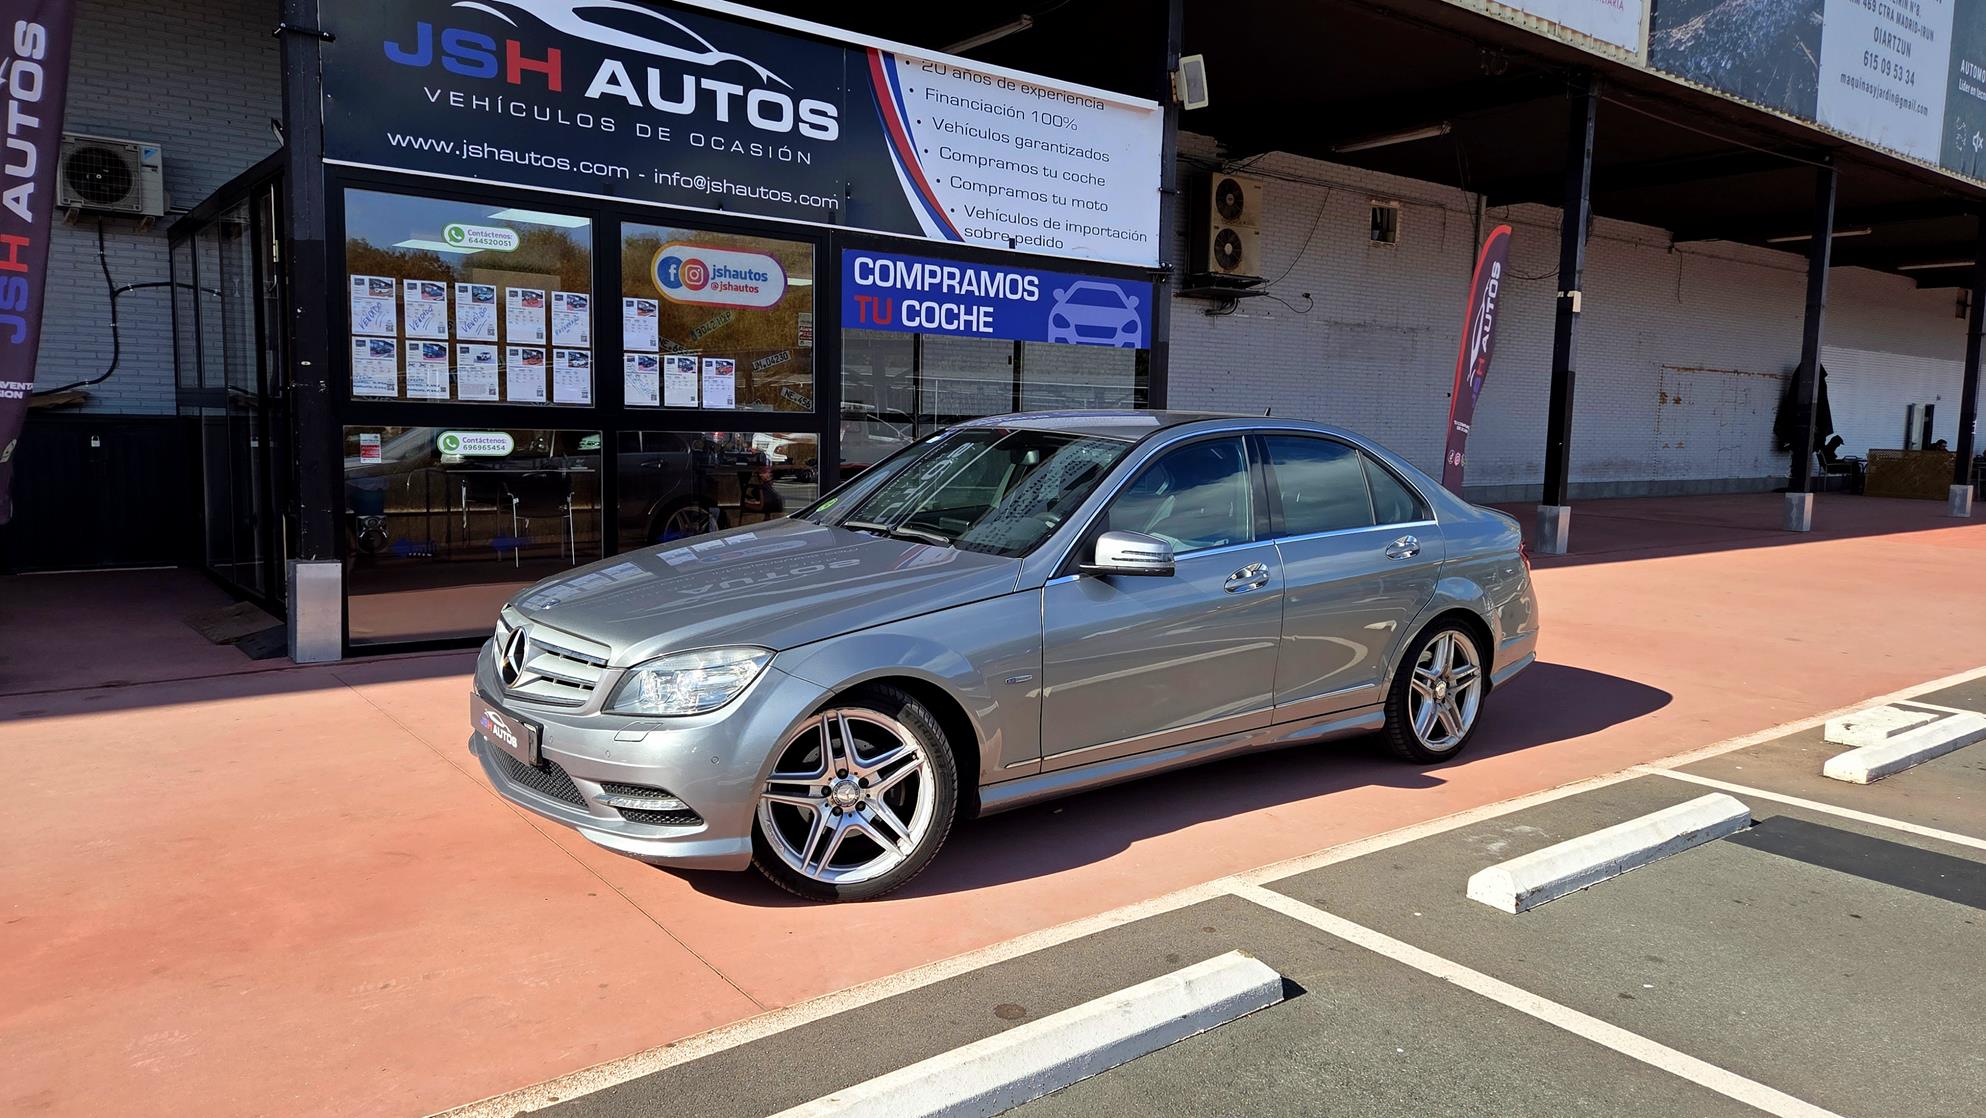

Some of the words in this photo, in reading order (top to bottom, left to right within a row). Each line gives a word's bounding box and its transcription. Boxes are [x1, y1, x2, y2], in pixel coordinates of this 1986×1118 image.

[1878, 3, 1895, 22] CTRA
[1873, 26, 1912, 58] OIARTZUN
[384, 21, 562, 92] JSH
[585, 58, 839, 141] AUTOS
[1863, 50, 1879, 71] 615
[1881, 58, 1891, 76] 09
[1893, 63, 1903, 82] 53
[1905, 69, 1915, 87] 34
[952, 68, 992, 86] años
[997, 77, 1016, 91] de
[1021, 83, 1105, 111] experiencia
[3, 20, 46, 223] AUTOS
[424, 86, 616, 132] VEHÍCULOS
[636, 123, 671, 142] DE
[690, 133, 811, 166] OCASIÓN
[925, 87, 1025, 120] Financiación
[1031, 110, 1078, 131] 100%
[932, 116, 1010, 144] Vehículos
[1015, 135, 1110, 162] garantizados
[387, 132, 630, 180] www.jshautos.com
[654, 168, 839, 210] info@jshautos.com
[939, 146, 1039, 176] Compramos
[1042, 166, 1058, 179] tu
[1062, 170, 1106, 187] coche
[950, 176, 1048, 204] Compramos
[1052, 192, 1067, 206] tu
[1071, 197, 1109, 212] moto
[467, 229, 513, 240] Contáctenos:
[468, 237, 512, 247] 644520051
[964, 204, 1038, 228] Vehículos
[1043, 216, 1061, 230] de
[1065, 219, 1147, 243] importación
[964, 226, 1010, 242] sobre
[1014, 233, 1064, 249] pedido
[711, 265, 768, 282] jshautos
[711, 282, 759, 294] @jshautos
[854, 256, 1040, 302] COMPRAMOS
[854, 295, 893, 325] TU
[901, 299, 994, 333] COCHE
[1481, 261, 1501, 353] AUTOS
[462, 437, 506, 445] Contáctenos:
[463, 444, 506, 452] 696965454
